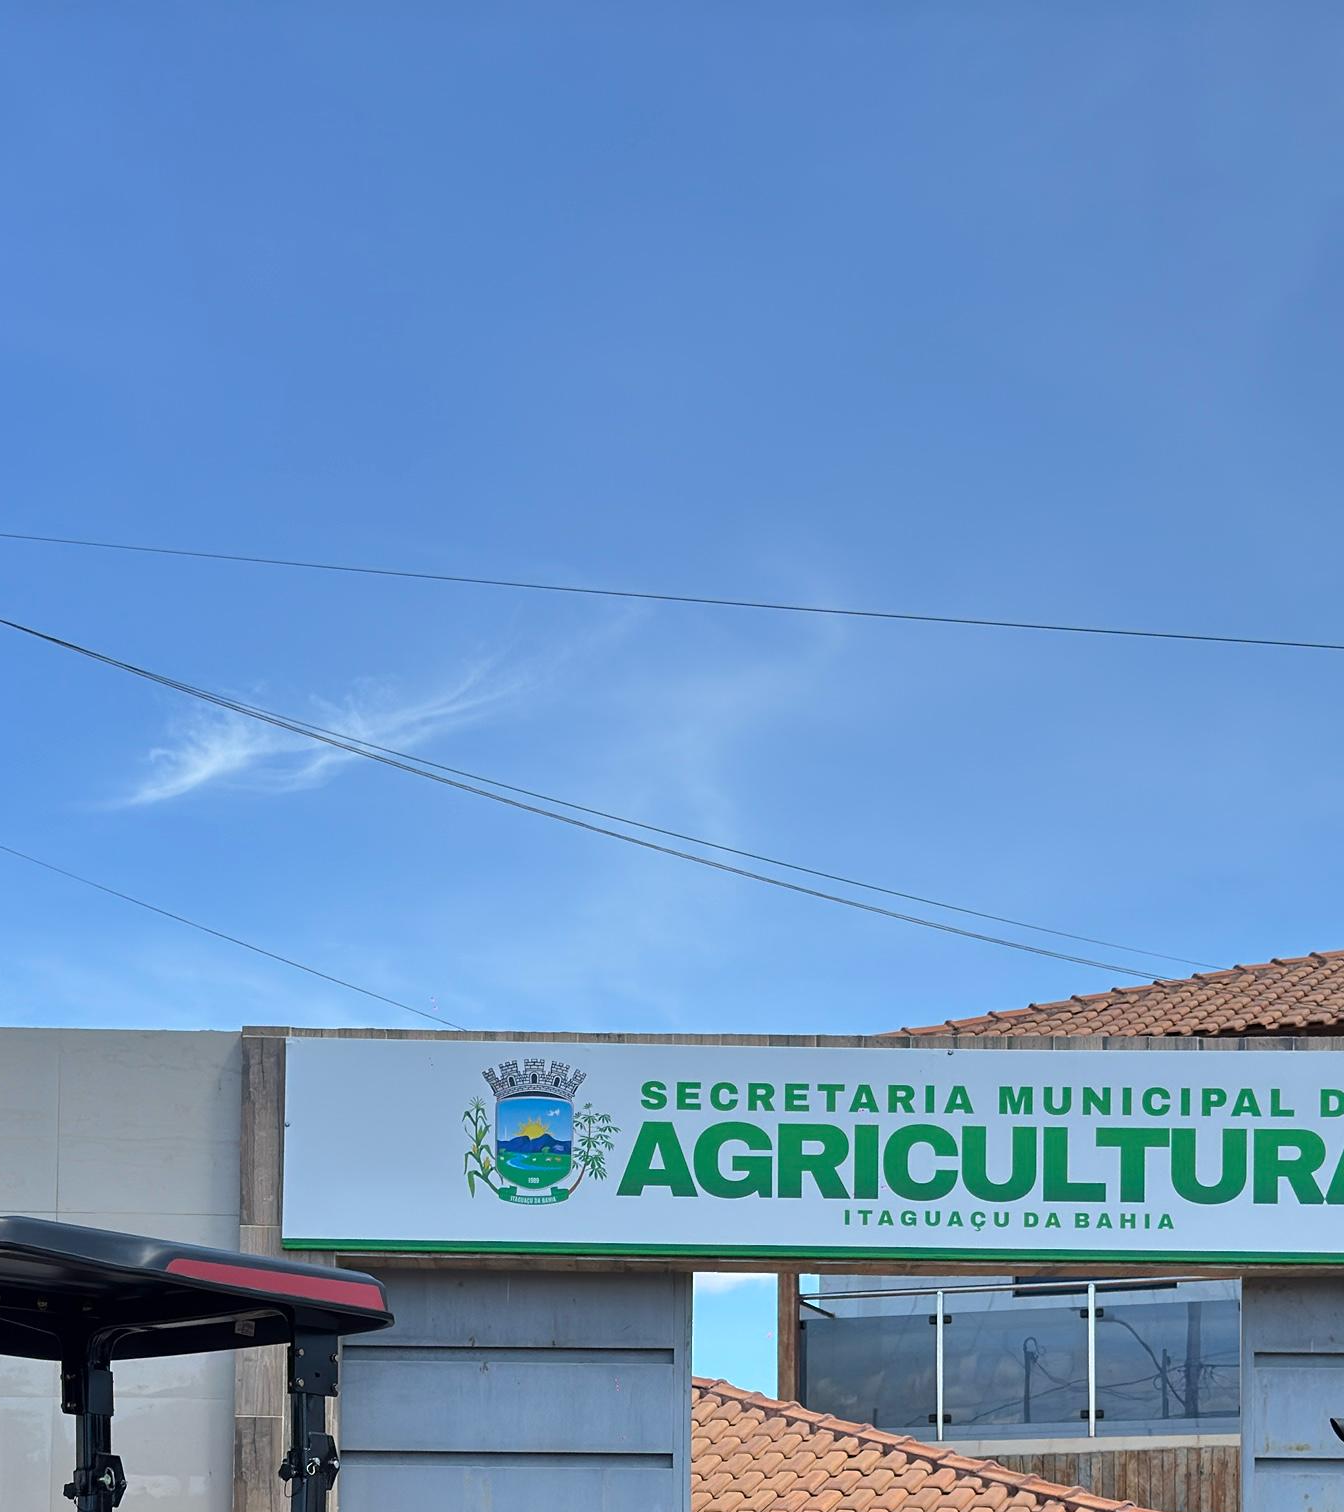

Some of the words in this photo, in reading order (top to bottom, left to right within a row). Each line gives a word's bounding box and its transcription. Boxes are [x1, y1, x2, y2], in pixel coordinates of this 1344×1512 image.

[640, 1080, 975, 1114] SECRETARIA
[998, 1086, 1296, 1118] MUNICIPAL
[843, 1209, 1010, 1232] ITAGUAÇU
[1023, 1211, 1062, 1229] DA
[1074, 1212, 1175, 1230] BAHIA
